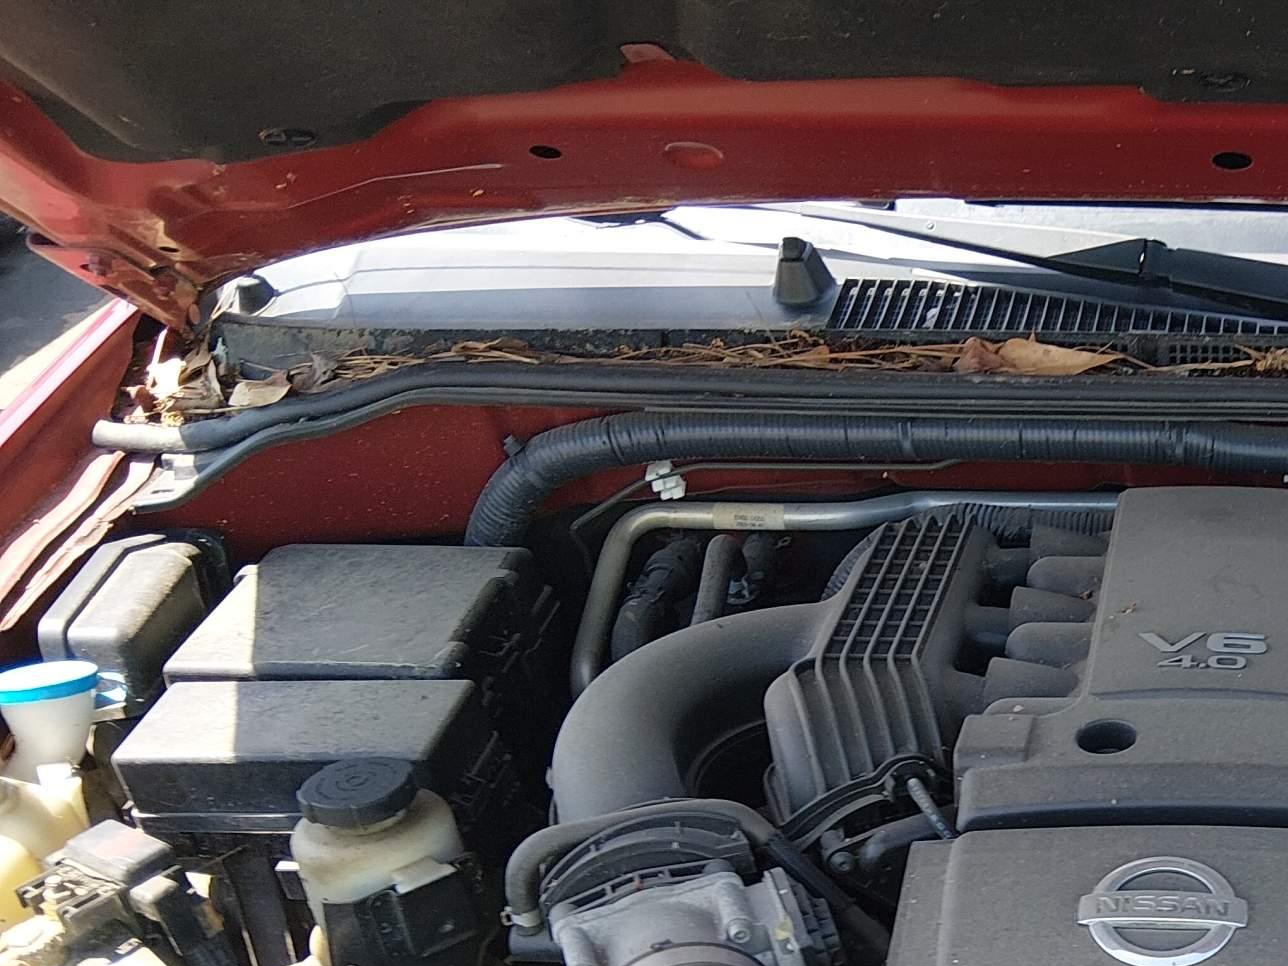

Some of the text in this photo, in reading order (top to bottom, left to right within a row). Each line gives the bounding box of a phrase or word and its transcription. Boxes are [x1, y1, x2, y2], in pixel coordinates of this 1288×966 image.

[1138, 632, 1268, 654] V6
[1156, 655, 1247, 669] 4.0
[1096, 894, 1230, 917] NISSAN
